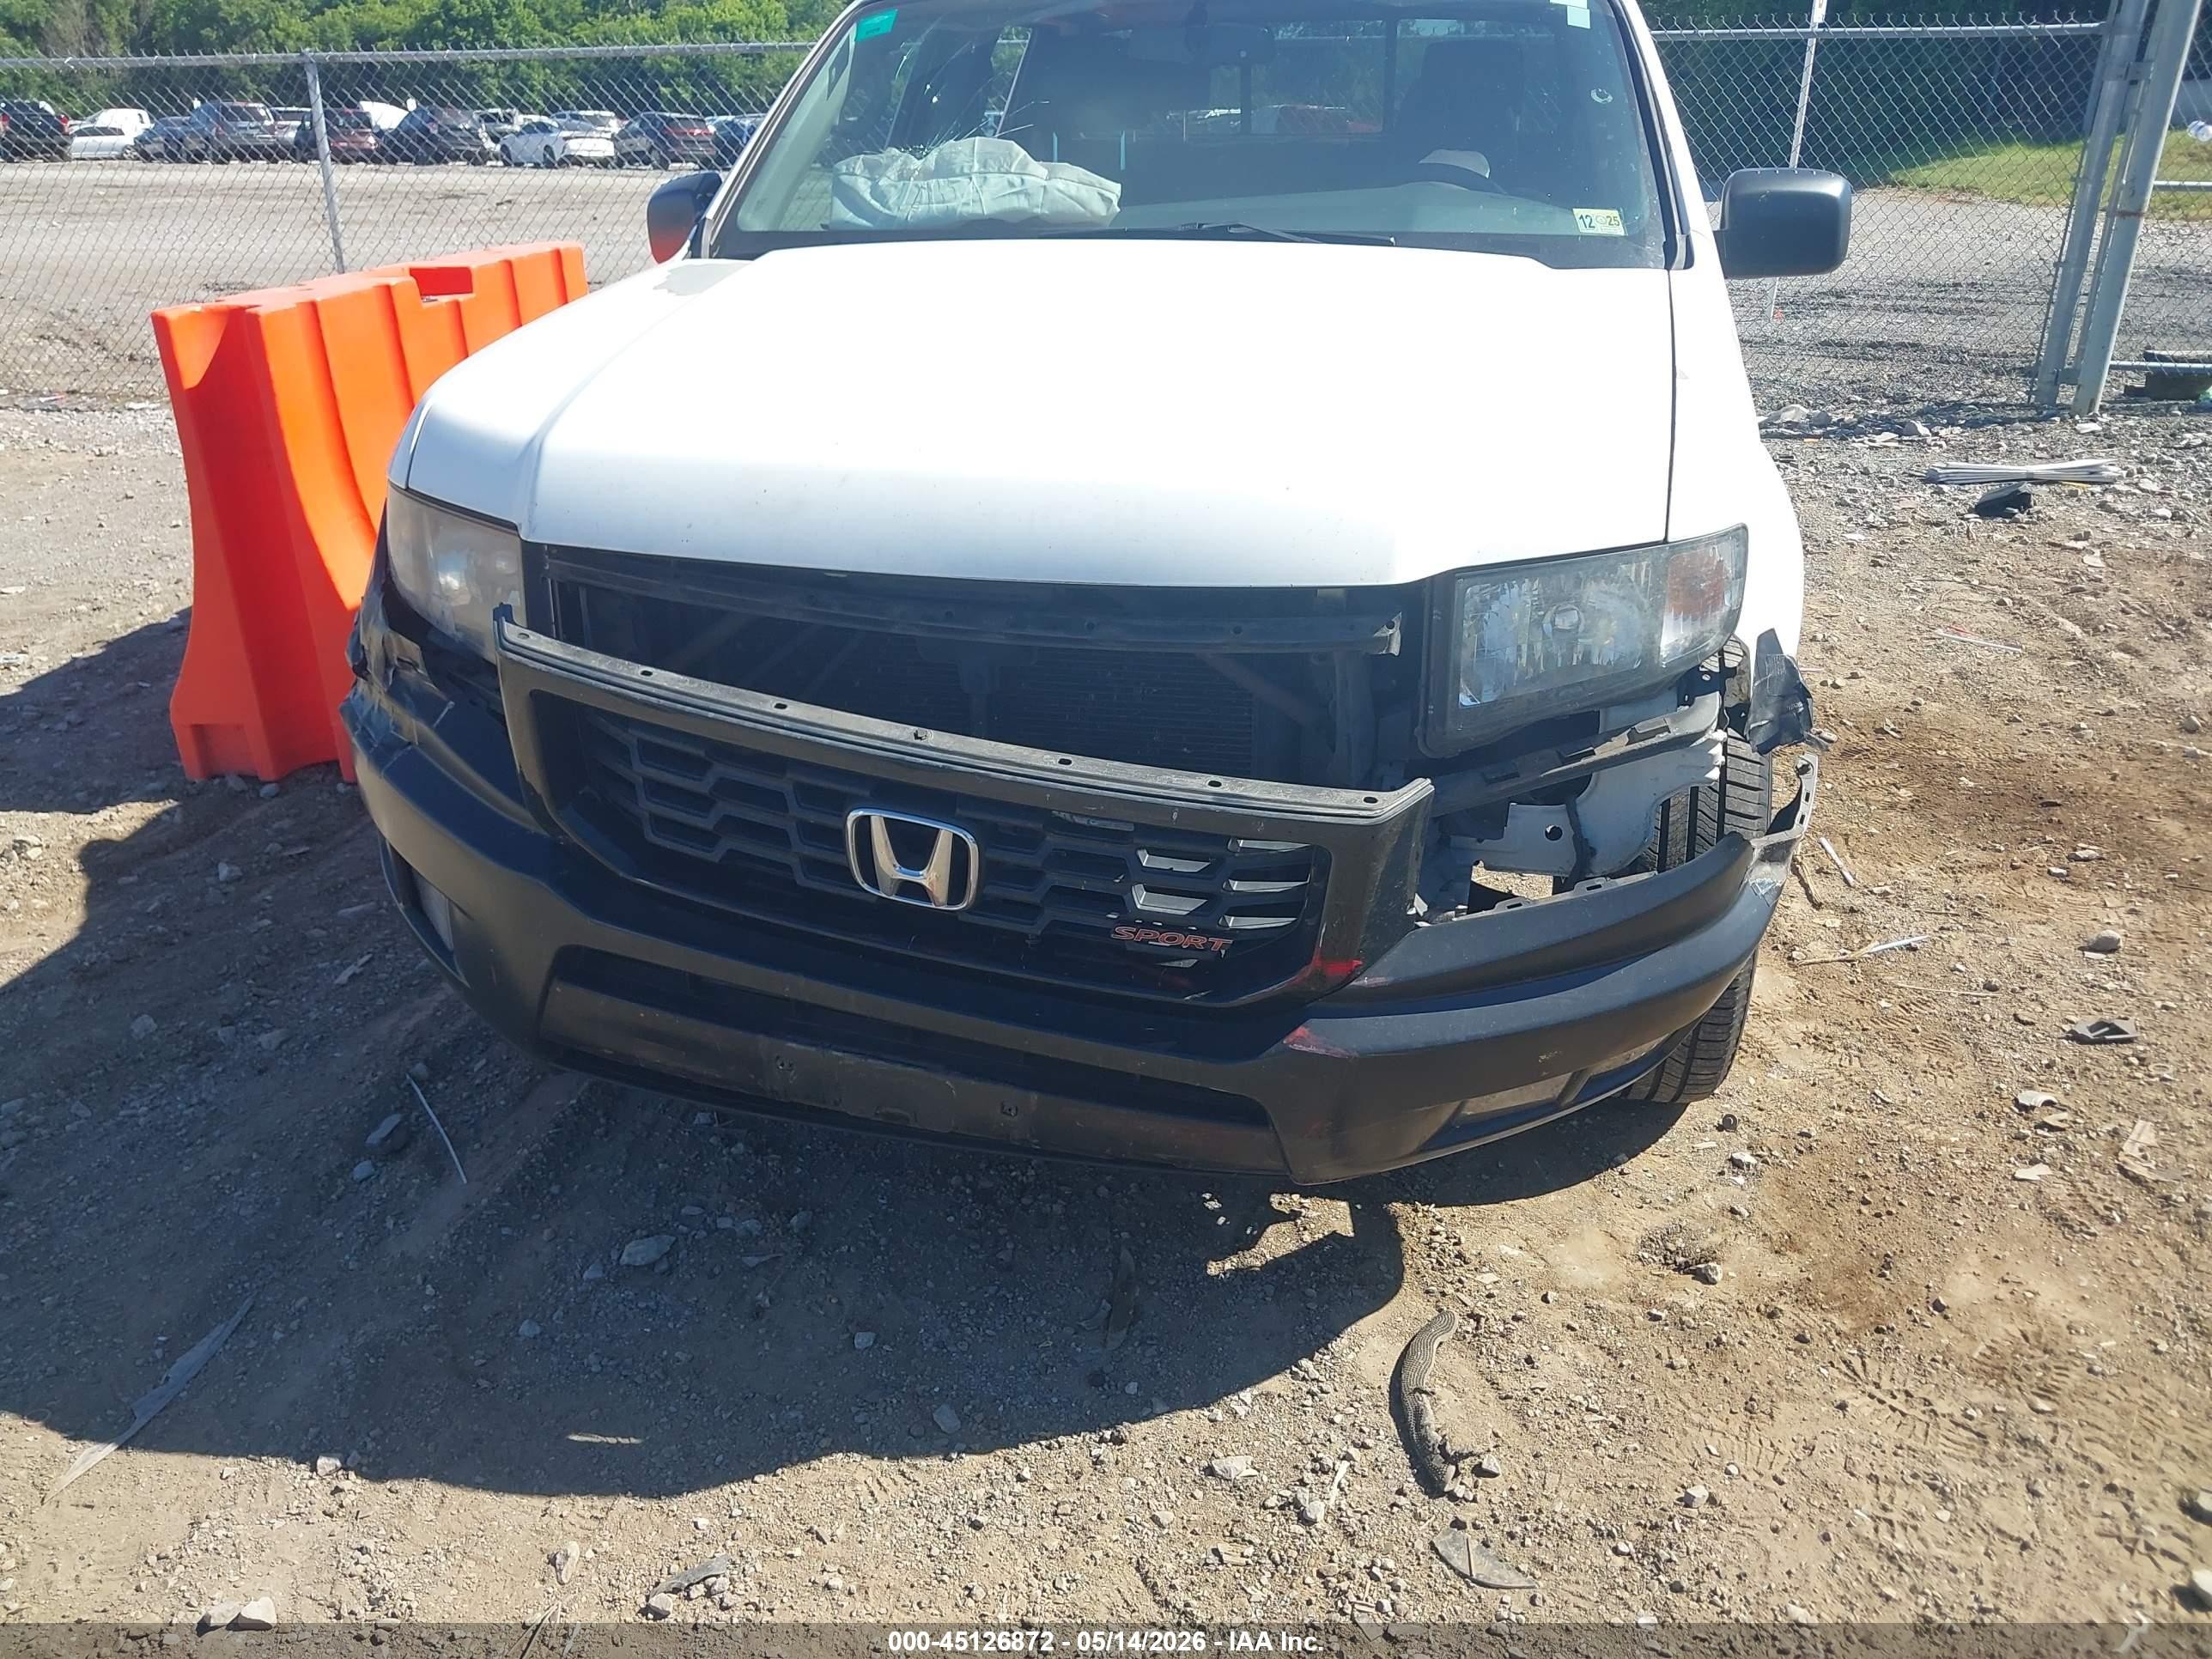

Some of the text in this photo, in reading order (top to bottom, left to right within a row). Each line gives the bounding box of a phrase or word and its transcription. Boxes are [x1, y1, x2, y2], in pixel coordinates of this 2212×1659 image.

[1579, 215, 1620, 228] 12 25
[1111, 926, 1233, 951] SPORT
